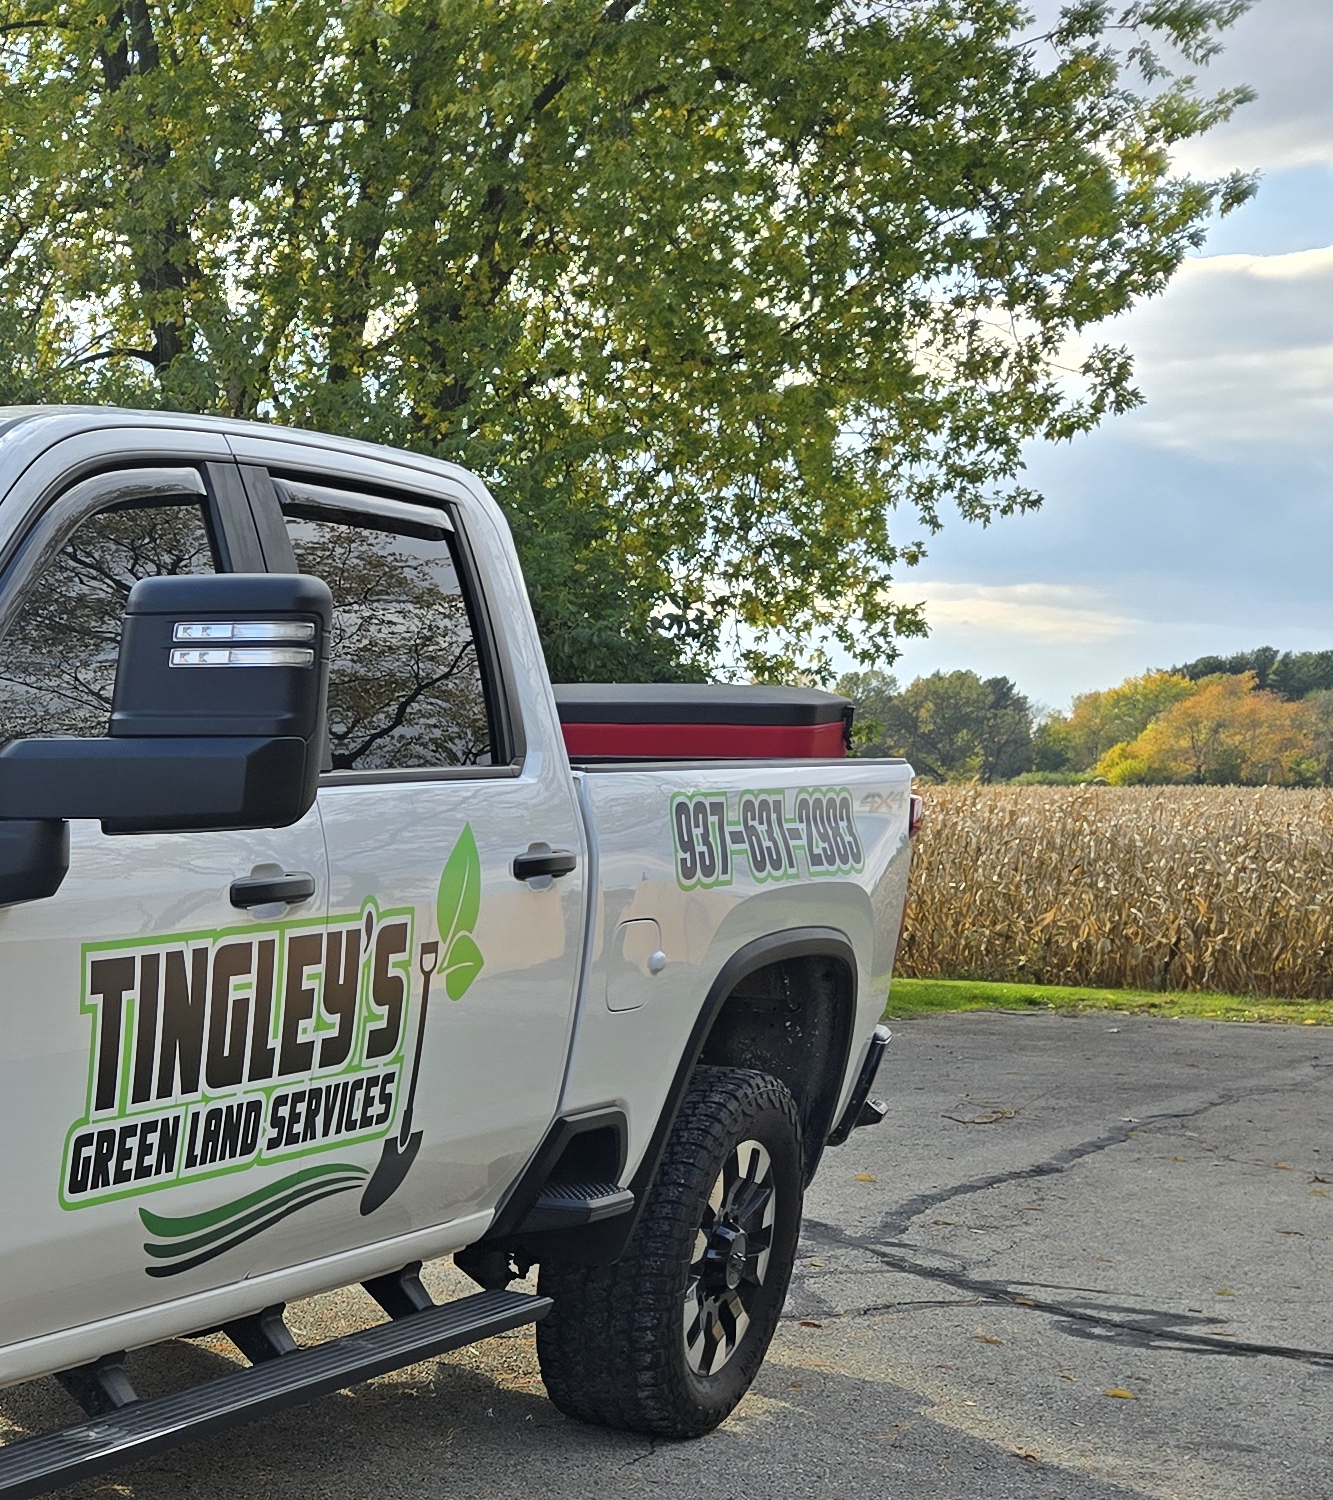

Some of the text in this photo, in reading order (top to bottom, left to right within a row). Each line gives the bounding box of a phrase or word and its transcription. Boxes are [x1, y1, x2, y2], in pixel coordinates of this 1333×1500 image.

[675, 796, 862, 880] 937-631-2983
[90, 909, 409, 1112] TINGLEY'S
[68, 1071, 396, 1195] GREEN LAND SERVICES
